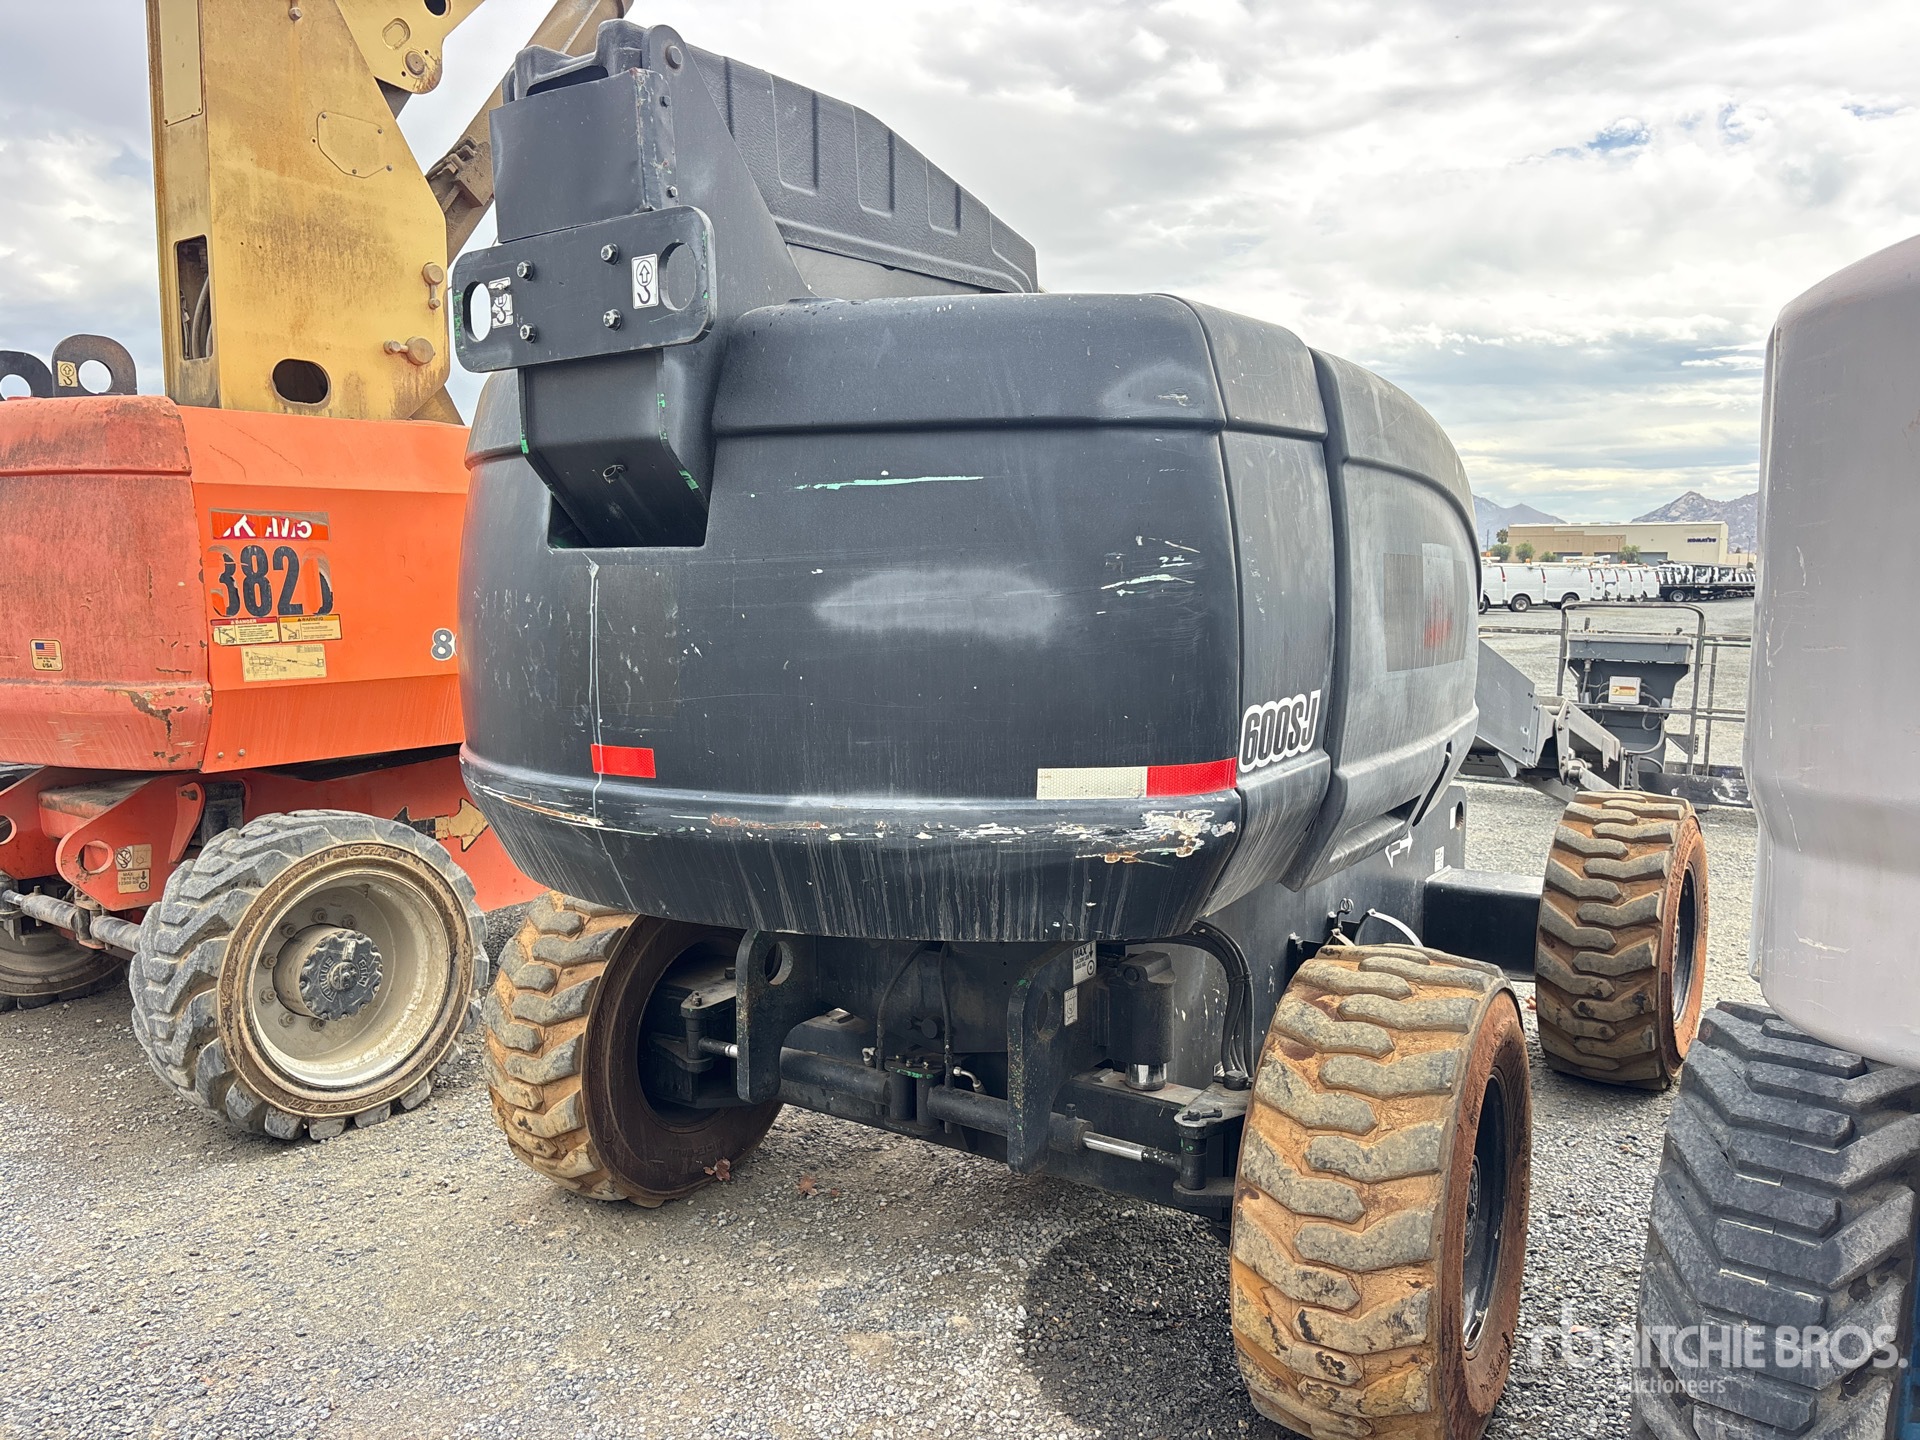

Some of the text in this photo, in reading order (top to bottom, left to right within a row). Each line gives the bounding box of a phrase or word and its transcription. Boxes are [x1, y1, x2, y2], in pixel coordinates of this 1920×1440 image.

[430, 627, 457, 661] 8
[1239, 689, 1321, 773] 600SJ
[1074, 945, 1087, 959] MAX
